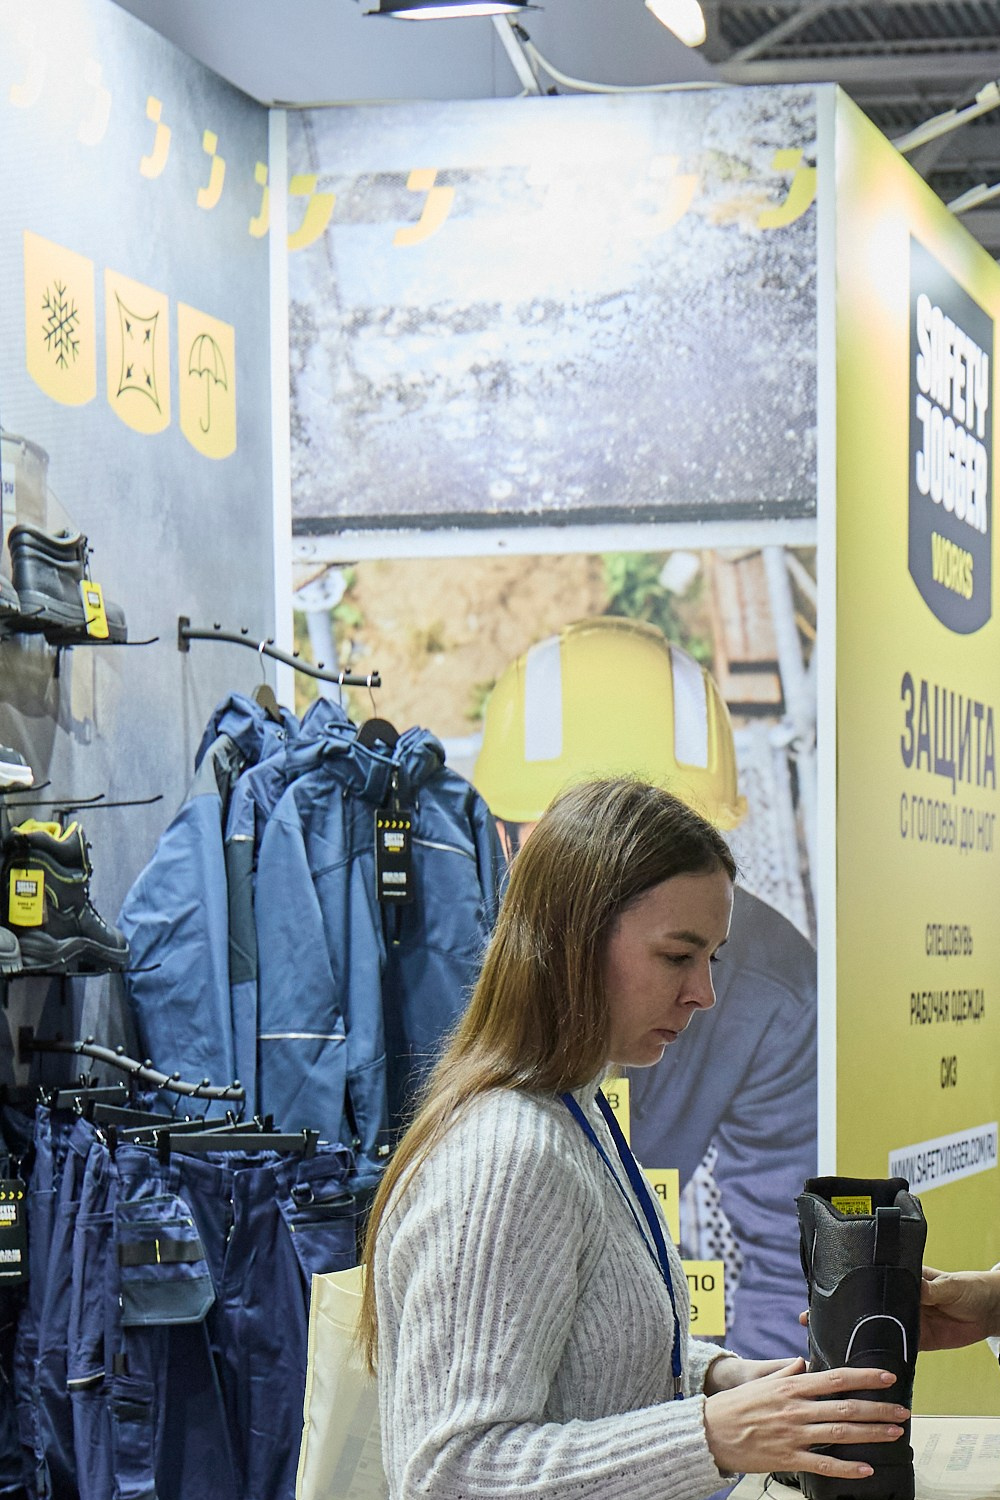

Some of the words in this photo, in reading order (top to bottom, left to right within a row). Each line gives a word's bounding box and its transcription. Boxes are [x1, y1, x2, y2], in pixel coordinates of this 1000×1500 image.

[915, 293, 990, 439] SAFETY
[915, 394, 989, 535] JOGGER
[931, 531, 973, 600] WORKS
[900, 671, 996, 796] ЗАЩИТА
[900, 792, 908, 840] С
[911, 795, 958, 847] ГОЛОВЫ
[960, 806, 974, 856] ДО
[976, 809, 996, 853] НОГ
[925, 923, 974, 961] СПЕЦОБУВЬ
[910, 990, 950, 1026] РАБОЧАЯ
[951, 988, 985, 1026] ОДЕЖДА
[940, 1055, 957, 1089] СИЗ
[891, 1130, 997, 1186] WWW.SAFETYJOGGER.COM/RU
